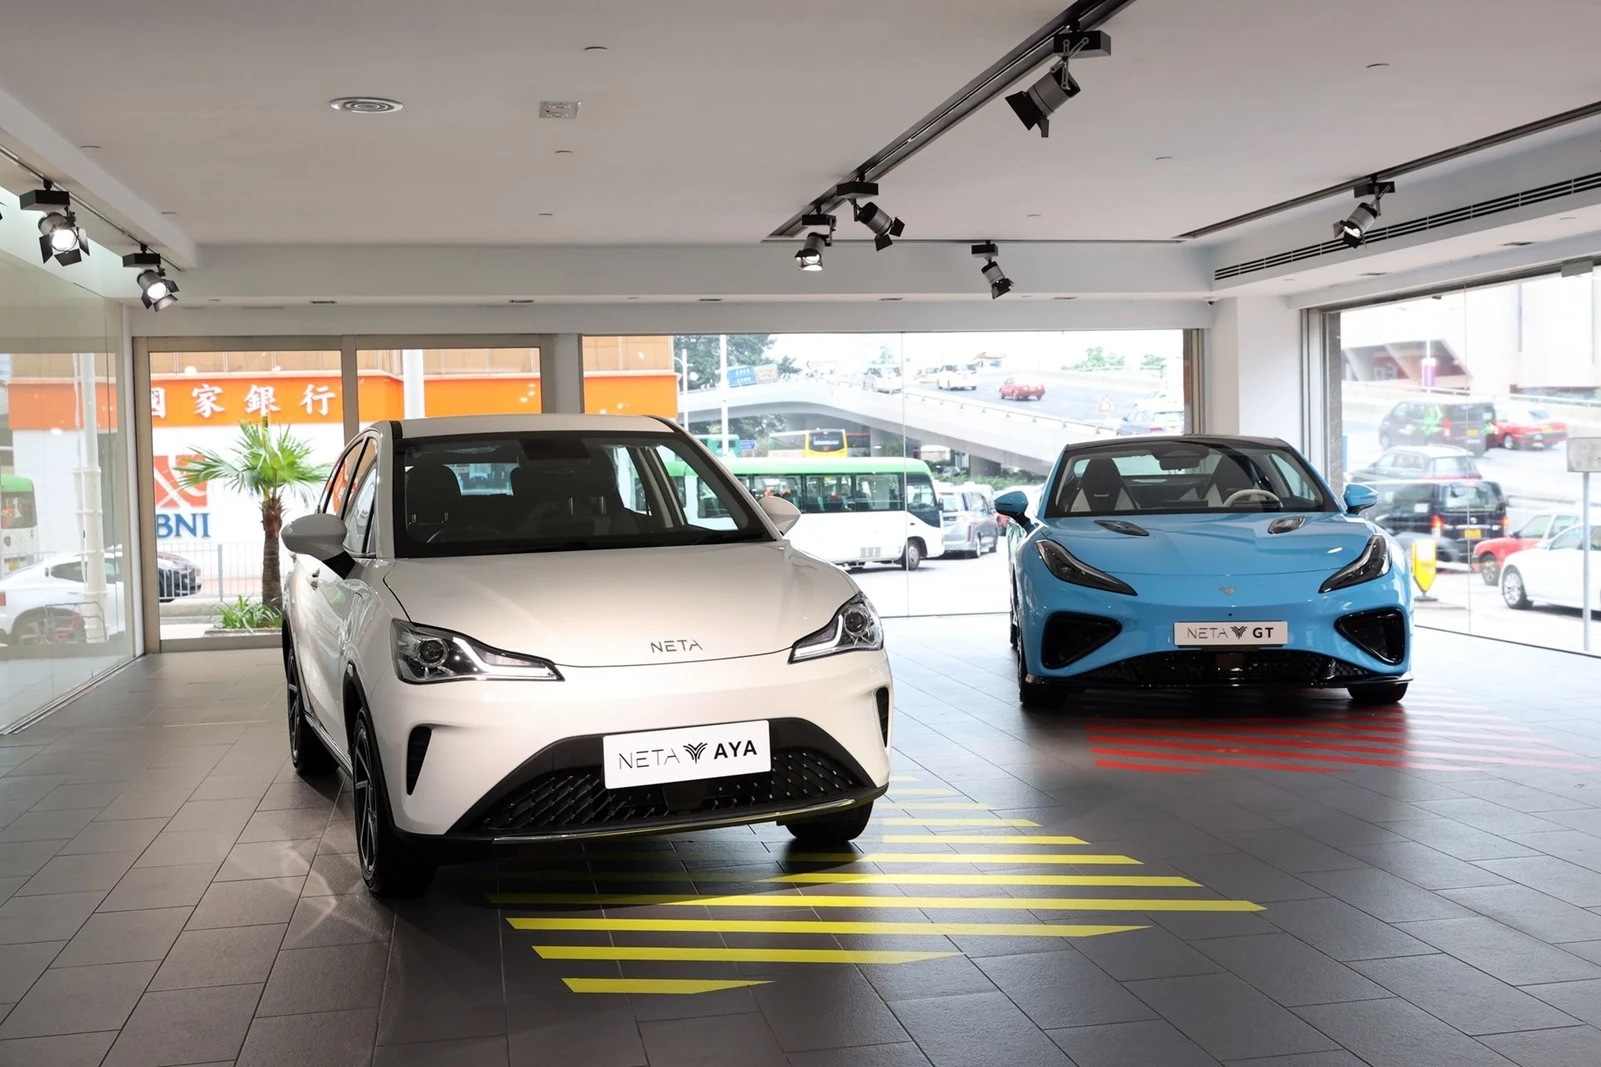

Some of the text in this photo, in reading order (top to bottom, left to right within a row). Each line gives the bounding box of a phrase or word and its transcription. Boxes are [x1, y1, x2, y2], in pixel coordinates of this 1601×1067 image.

[156, 513, 211, 538] BNI
[1187, 627, 1274, 639] NETA GT
[650, 639, 703, 653] NETA
[618, 739, 758, 770] NETA AYA
